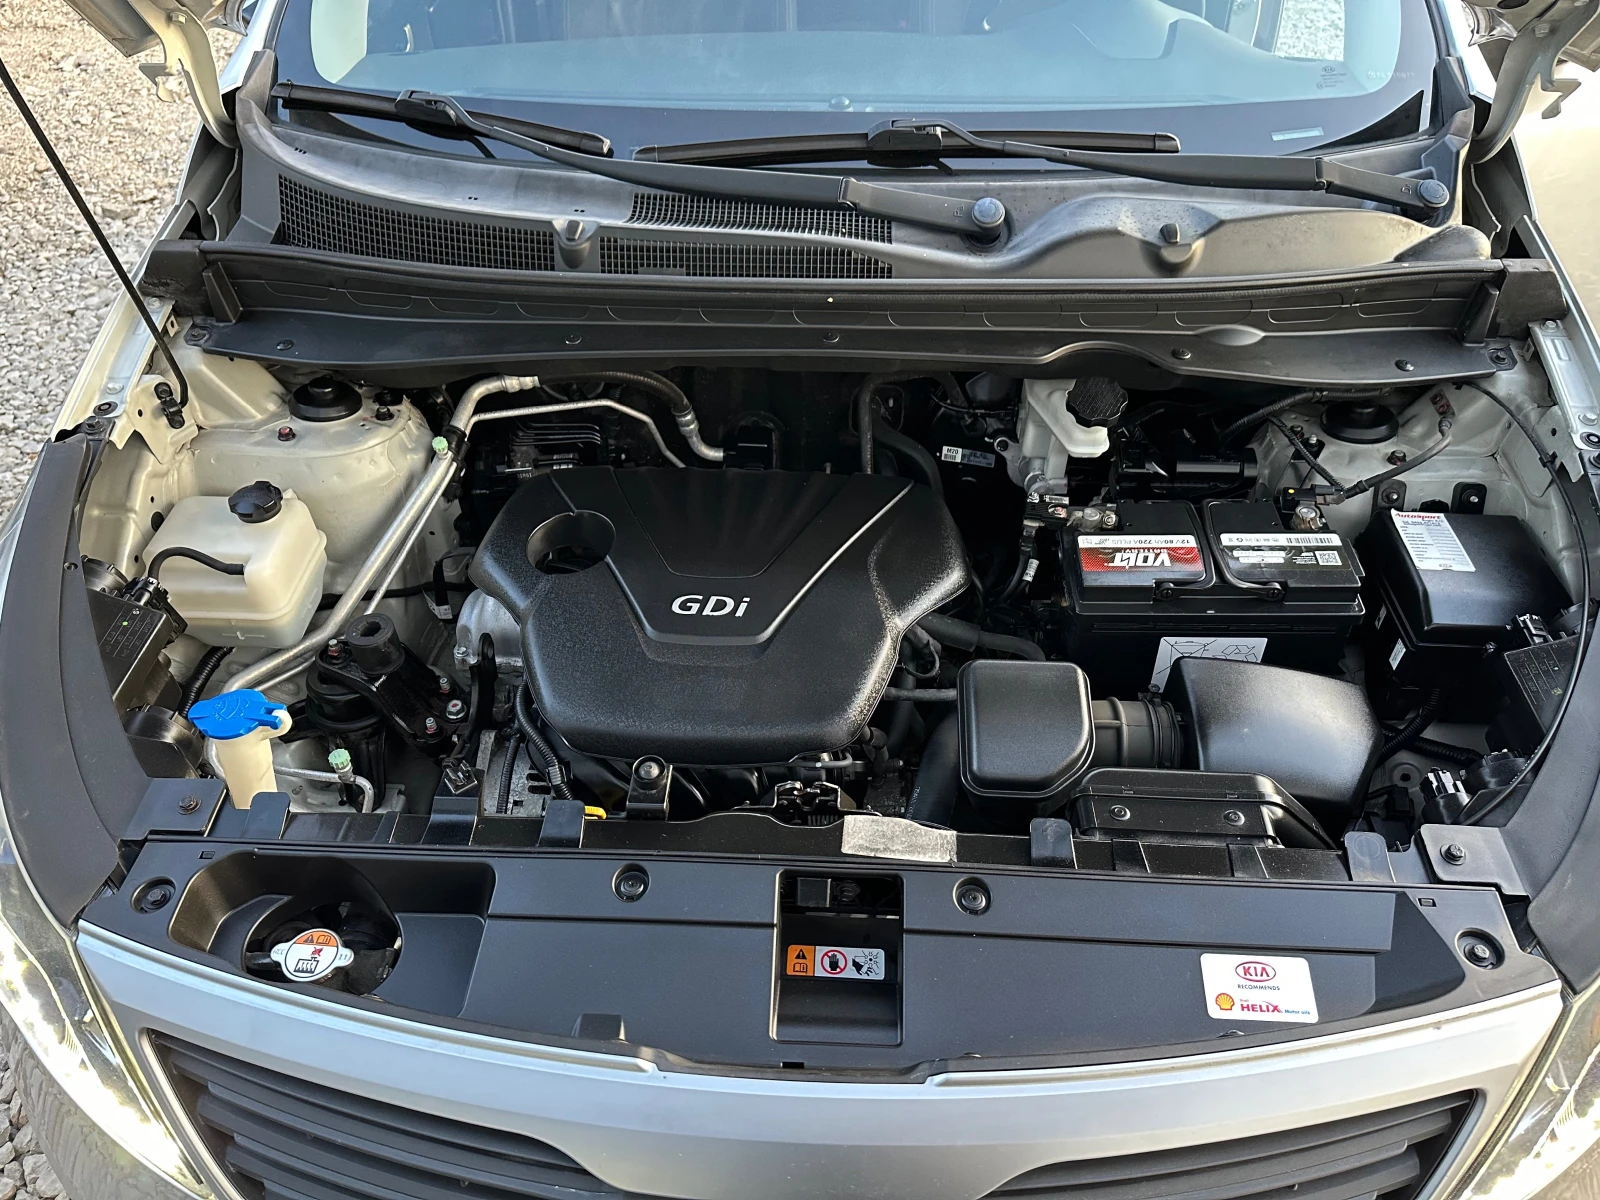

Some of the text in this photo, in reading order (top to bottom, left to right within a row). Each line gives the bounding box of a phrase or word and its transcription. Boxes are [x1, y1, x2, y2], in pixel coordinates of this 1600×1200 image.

[1107, 553, 1171, 568] VOLT
[671, 594, 751, 617] GDi
[1243, 966, 1271, 977] KIA
[1240, 1003, 1283, 1013] HELIX
